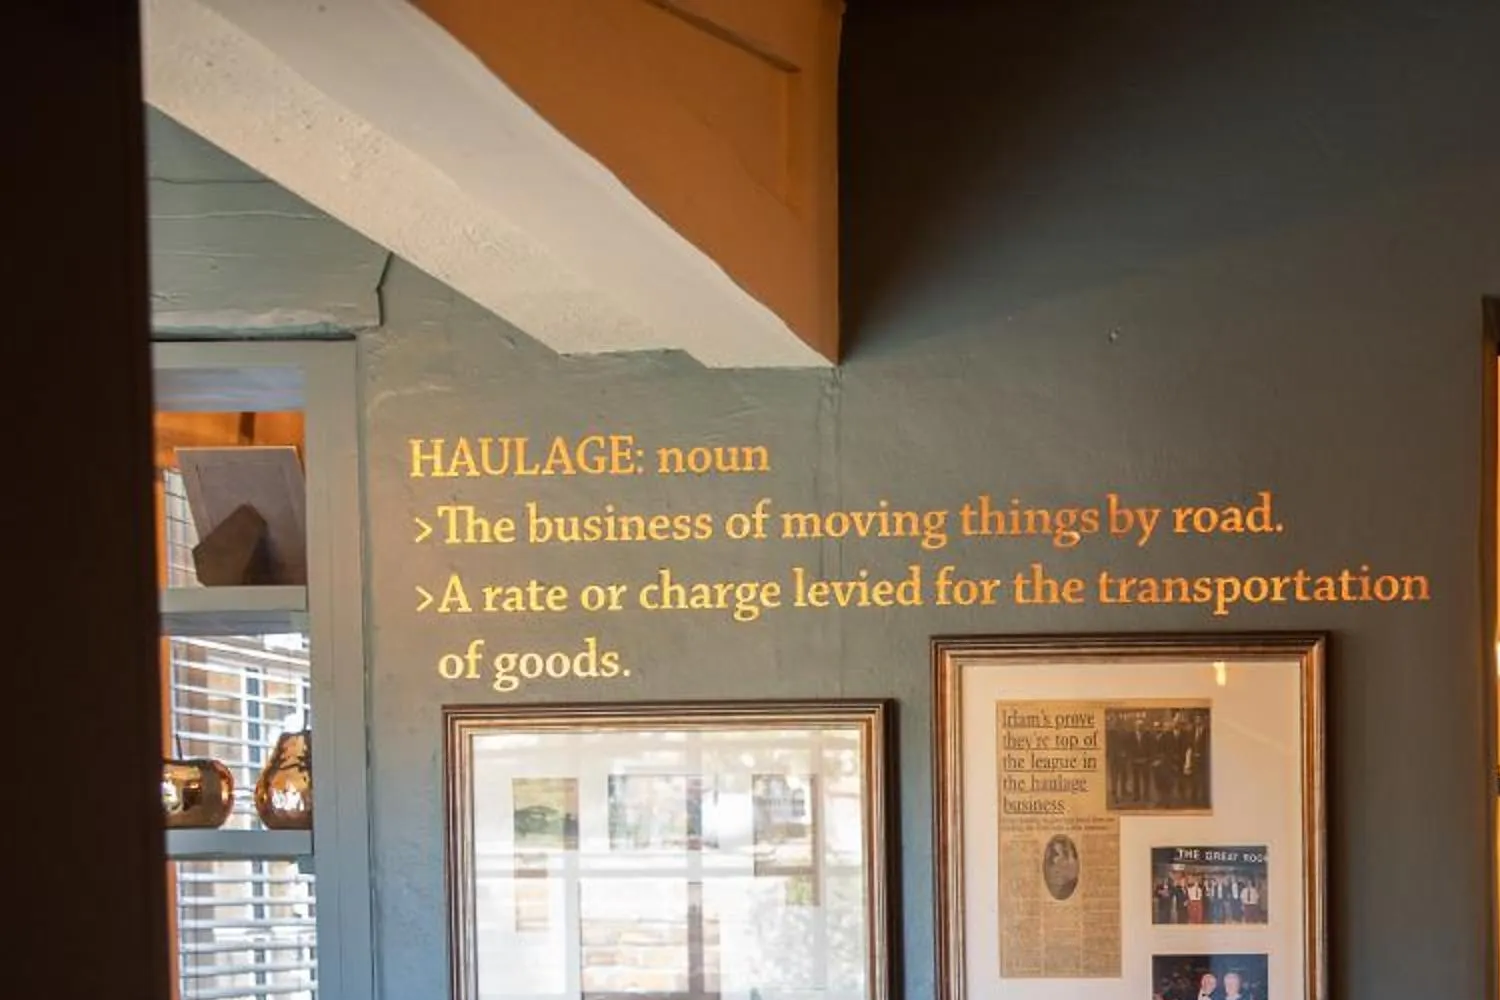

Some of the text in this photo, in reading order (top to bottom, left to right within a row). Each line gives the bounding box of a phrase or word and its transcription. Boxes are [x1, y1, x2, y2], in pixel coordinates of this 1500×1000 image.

[409, 435, 770, 478] HAULAGE: noun
[527, 502, 713, 543] business
[724, 498, 771, 540] of
[781, 500, 946, 549] moving
[961, 495, 1099, 548] things
[1107, 494, 1161, 546] by
[1173, 491, 1285, 534] road.
[482, 577, 569, 612] rate
[580, 582, 627, 611] or
[639, 568, 781, 621] charge
[793, 566, 924, 607] levied
[935, 565, 1001, 606] for
[1015, 563, 1085, 604] the
[1099, 564, 1431, 617] transportation
[437, 637, 632, 692] of goods.
[1055, 712, 1095, 730] prove
[1003, 730, 1099, 750] they're top of
[1003, 752, 1098, 772] the league in
[1003, 774, 1088, 794] the haulage
[1003, 795, 1066, 812] business
[1176, 847, 1201, 860] THE
[1204, 851, 1239, 862] GREAT
